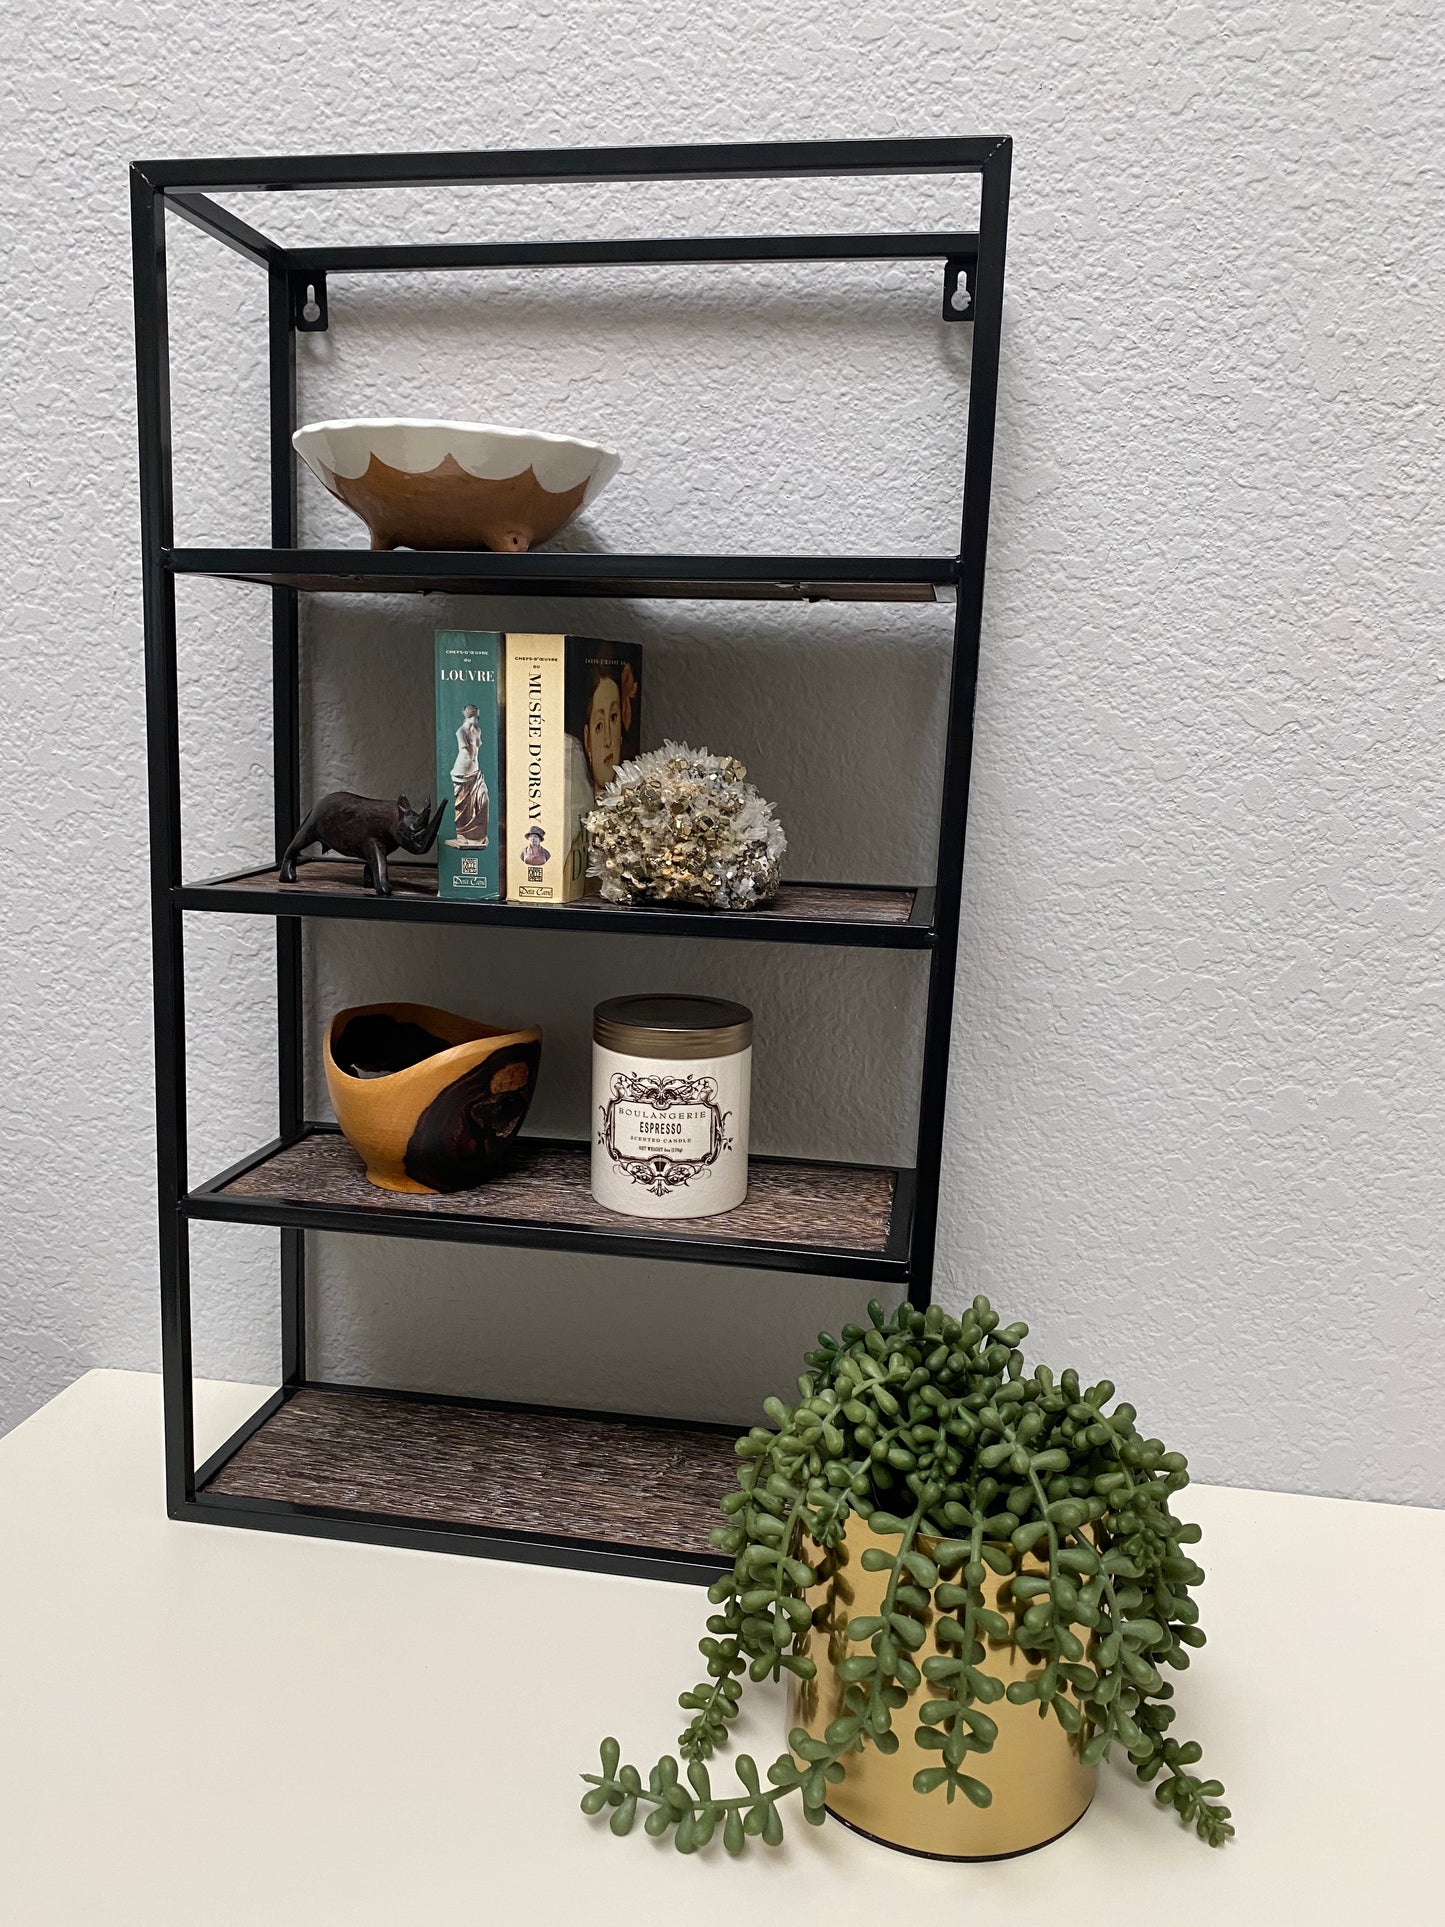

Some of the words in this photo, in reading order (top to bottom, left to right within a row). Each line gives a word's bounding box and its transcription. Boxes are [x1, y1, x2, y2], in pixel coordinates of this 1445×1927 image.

[441, 669, 495, 682] LOUVRE
[528, 672, 546, 738] MUSÉE
[528, 744, 542, 823] D'ORSAY
[618, 1107, 707, 1120] BOULANGERIE
[639, 1121, 682, 1135] ESPRESSO
[630, 1135, 661, 1143] SCENTED
